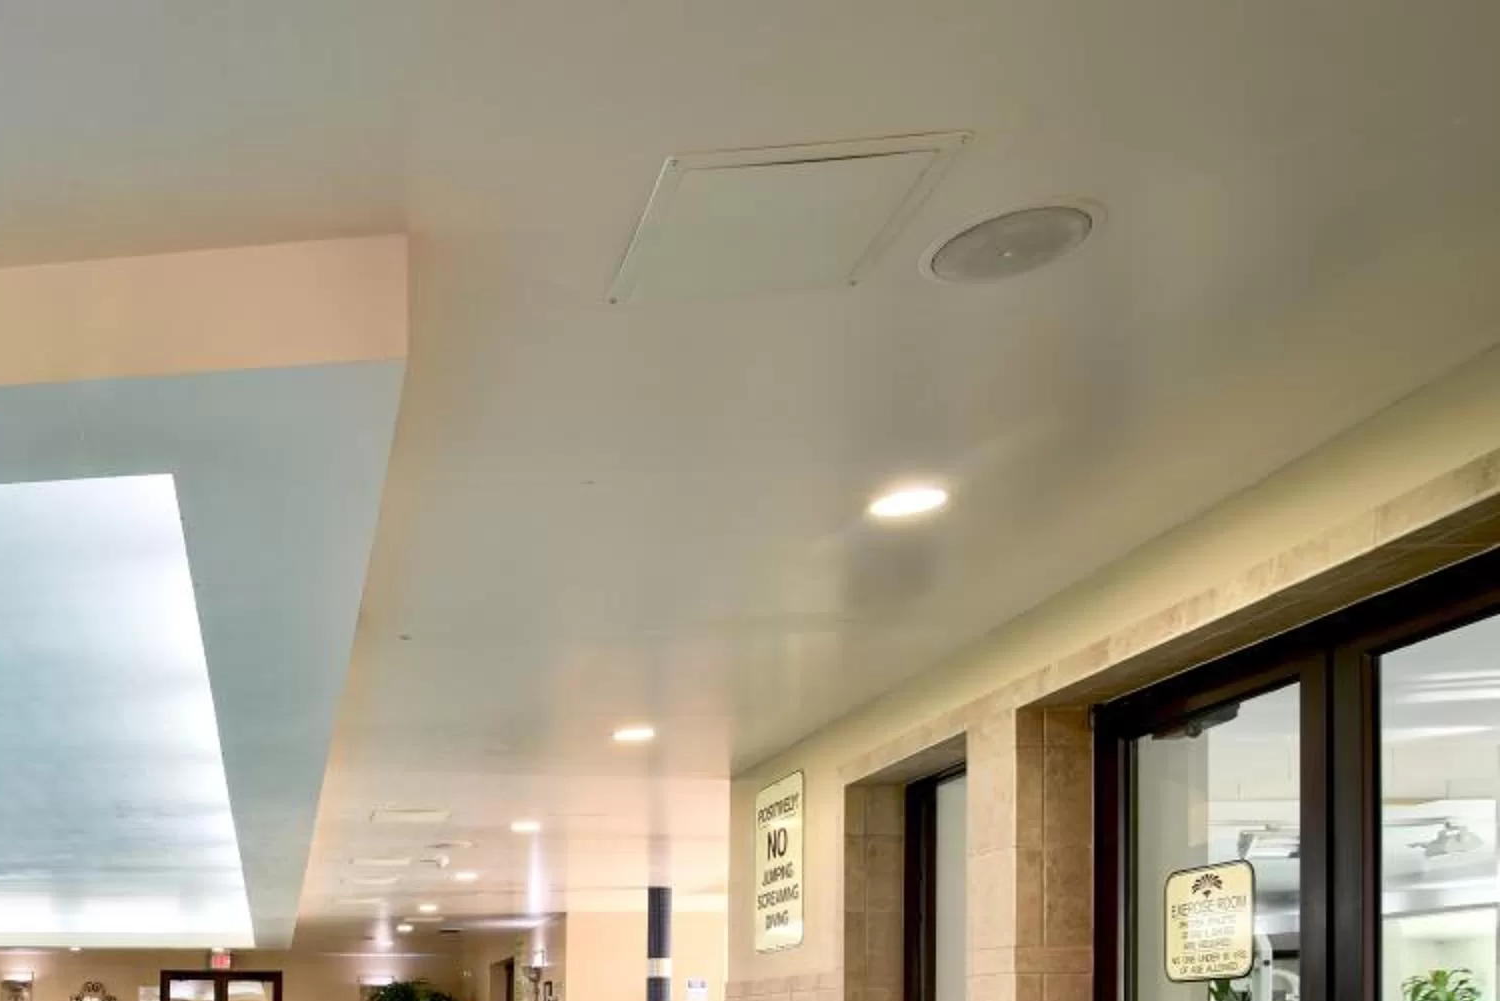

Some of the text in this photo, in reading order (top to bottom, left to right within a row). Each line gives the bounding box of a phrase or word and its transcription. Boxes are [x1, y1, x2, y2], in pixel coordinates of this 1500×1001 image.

[757, 792, 799, 824] POSITIVELY
[766, 827, 788, 861] NO
[761, 862, 794, 886] JUMPING
[757, 884, 799, 910] SCREAMING
[765, 910, 789, 931] DIVING
